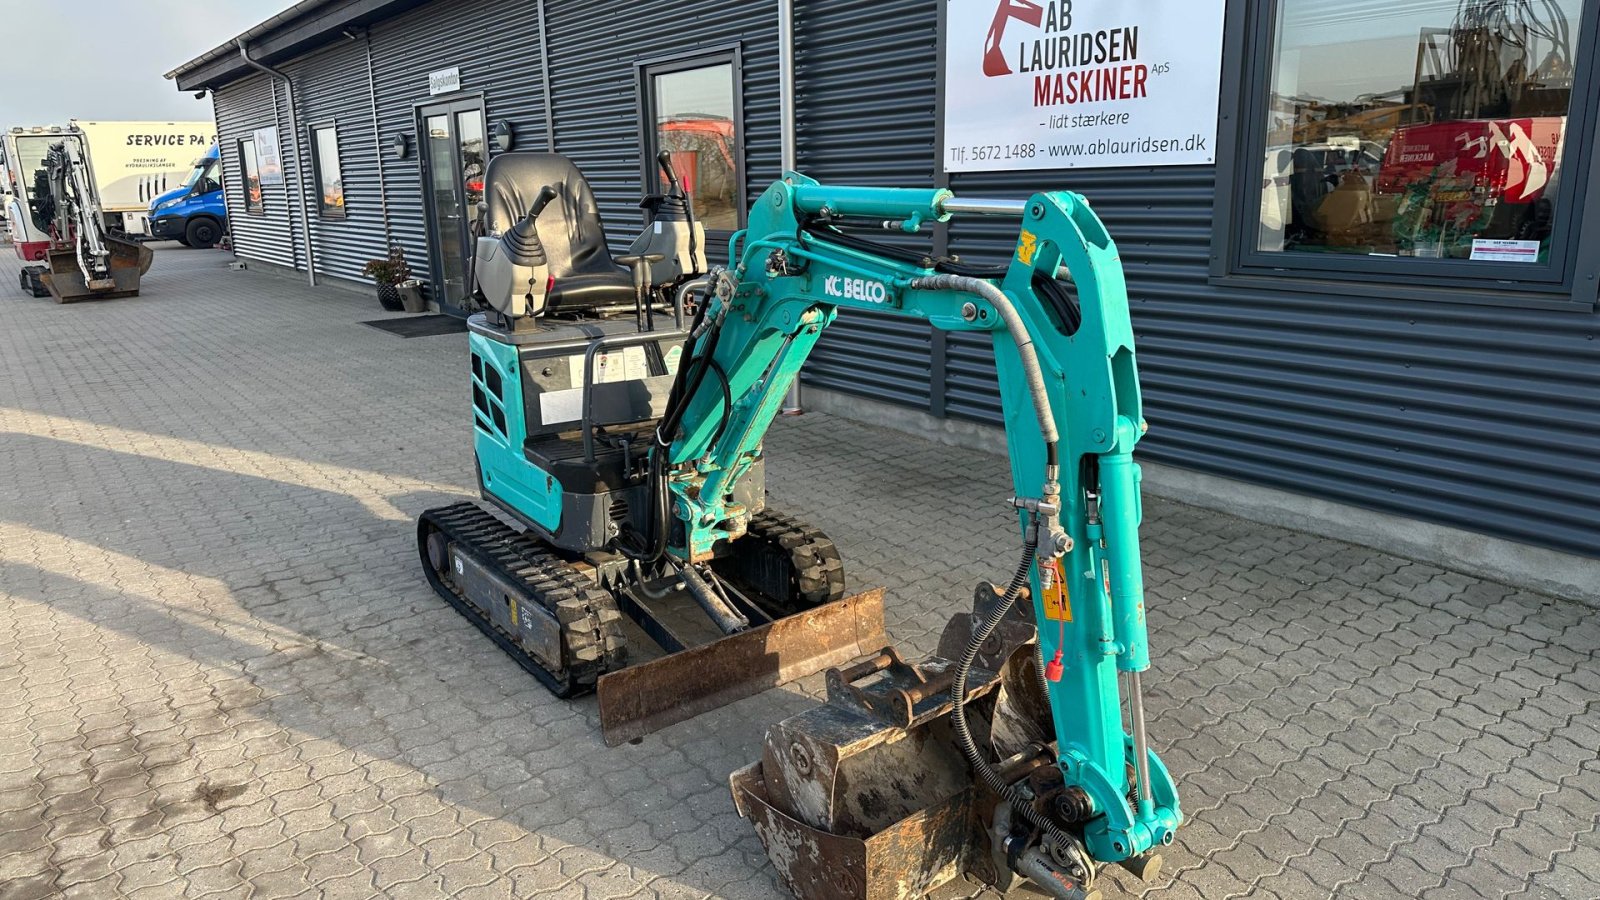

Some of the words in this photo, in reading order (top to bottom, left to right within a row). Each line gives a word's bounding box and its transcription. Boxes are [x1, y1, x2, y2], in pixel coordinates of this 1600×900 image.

[1045, 0, 1072, 33] AB
[1019, 26, 1139, 73] LAURIDSEN
[430, 72, 458, 91] Salgskontor
[1034, 64, 1148, 107] MASKINER
[1151, 62, 1170, 75] ApS
[1048, 114, 1069, 130] lidt
[1071, 111, 1130, 127] stærkere
[126, 134, 185, 146] SERVICE
[950, 147, 968, 165] Tlf.
[971, 144, 1001, 161] 5672
[1004, 143, 1036, 160] 1488
[1048, 134, 1206, 157] www.ablauridsen.dk
